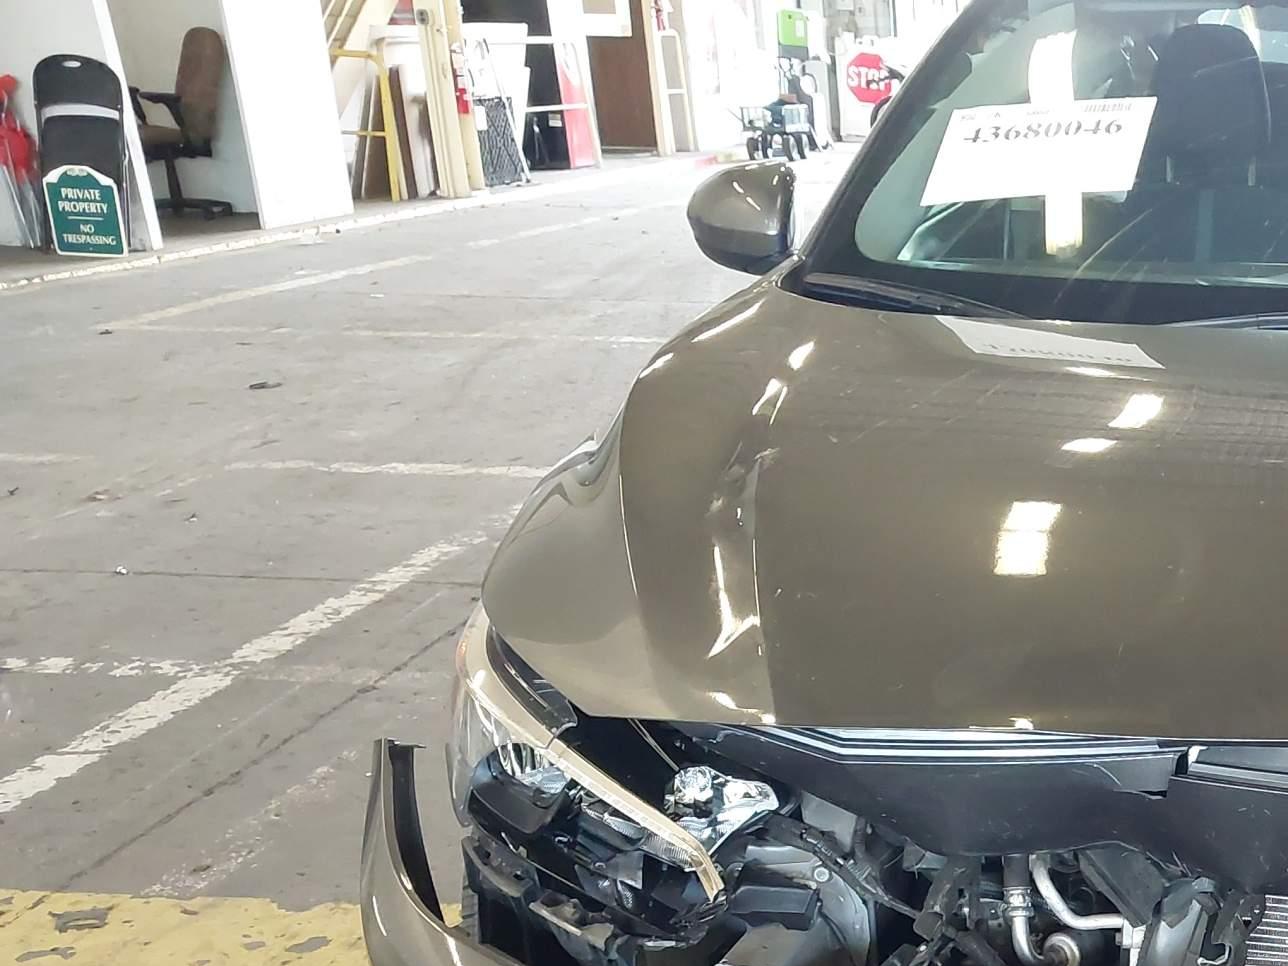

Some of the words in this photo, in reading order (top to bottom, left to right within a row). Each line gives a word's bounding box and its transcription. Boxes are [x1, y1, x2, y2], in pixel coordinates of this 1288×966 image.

[847, 65, 890, 91] STOP
[963, 119, 1122, 143] 43680046
[60, 187, 102, 201] PRIVATE
[57, 201, 108, 214] PROPERTY
[79, 223, 95, 234] NO
[62, 233, 117, 246] TRESPASSING
